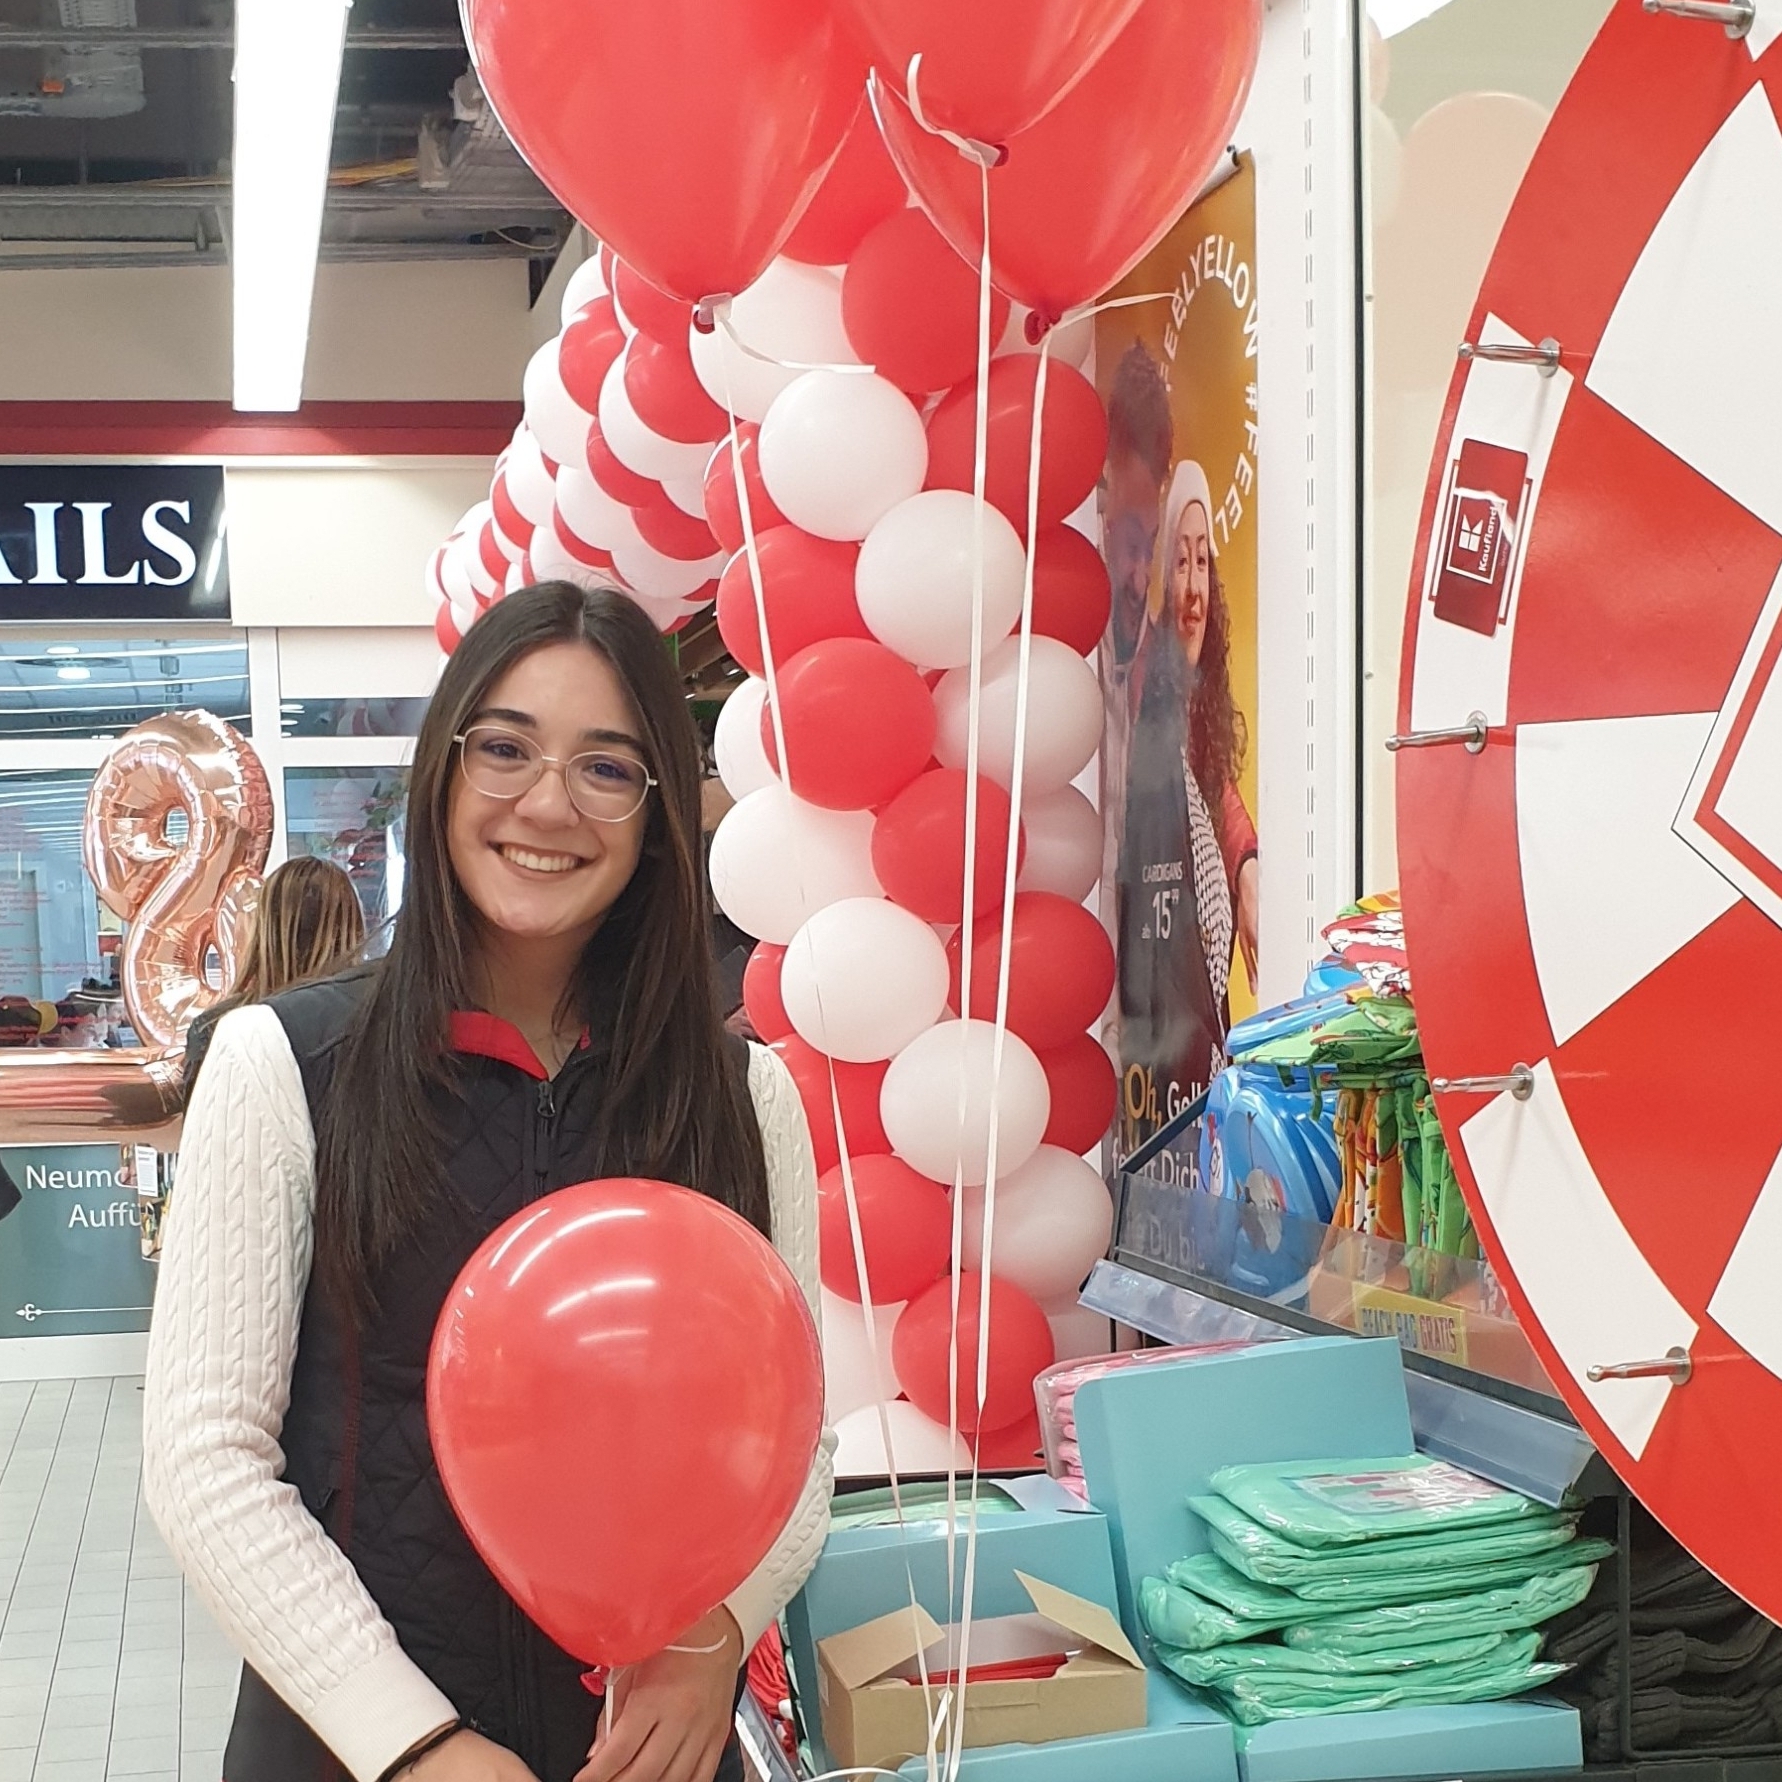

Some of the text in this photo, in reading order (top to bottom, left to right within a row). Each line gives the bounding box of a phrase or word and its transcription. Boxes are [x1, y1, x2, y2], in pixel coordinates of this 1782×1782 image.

[0, 500, 197, 587] ILS
[1478, 506, 1498, 573] Kaufland
[1142, 861, 1183, 884] CARDIGANS
[1161, 1149, 1199, 1190] Dich
[1419, 1314, 1456, 1354] GRATIS
